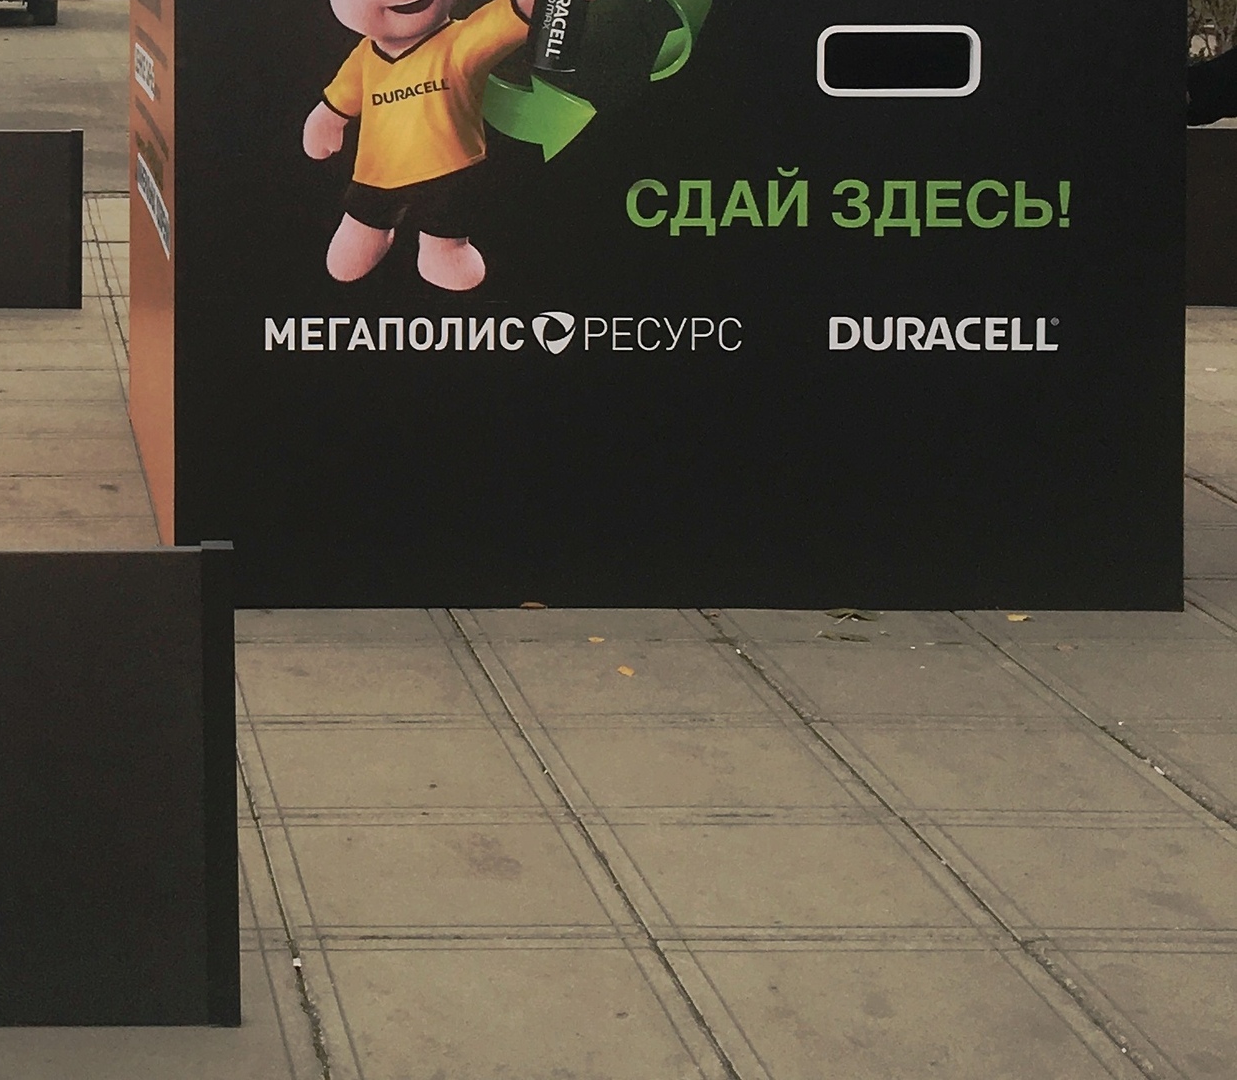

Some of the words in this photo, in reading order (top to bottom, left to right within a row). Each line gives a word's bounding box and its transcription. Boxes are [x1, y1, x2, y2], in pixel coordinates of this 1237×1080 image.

[371, 78, 450, 106] DURACELL
[625, 167, 810, 237] СДАЙ
[831, 178, 1072, 237] ЗДЕСЬ!
[263, 316, 526, 352] МЕГАПОЛИС
[583, 317, 743, 352] РЕСУРС
